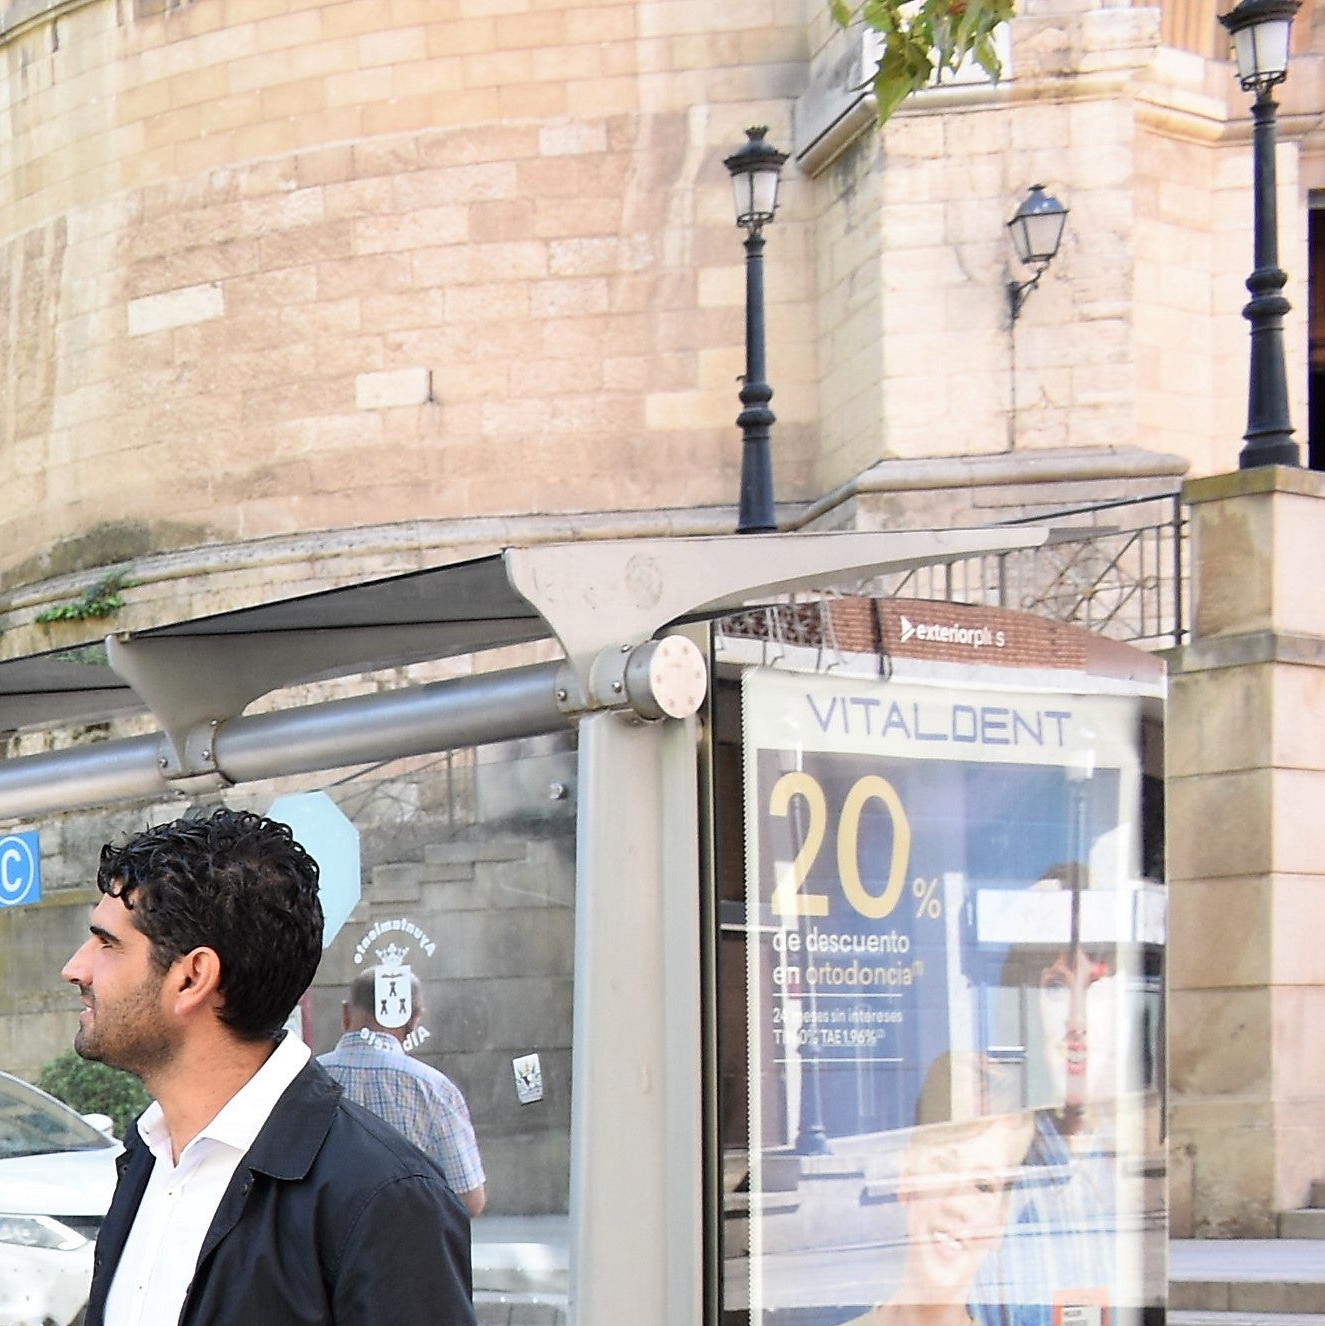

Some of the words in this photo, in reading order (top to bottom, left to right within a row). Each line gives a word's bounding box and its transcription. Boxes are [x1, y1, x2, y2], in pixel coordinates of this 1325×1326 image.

[916, 623, 1006, 649] exteriorpls
[806, 693, 1072, 747] VITALDENT
[0, 848, 22, 893] C
[772, 927, 801, 952] de
[806, 926, 911, 953] descuento
[772, 964, 801, 985] en
[821, 1029, 841, 1045] TAE
